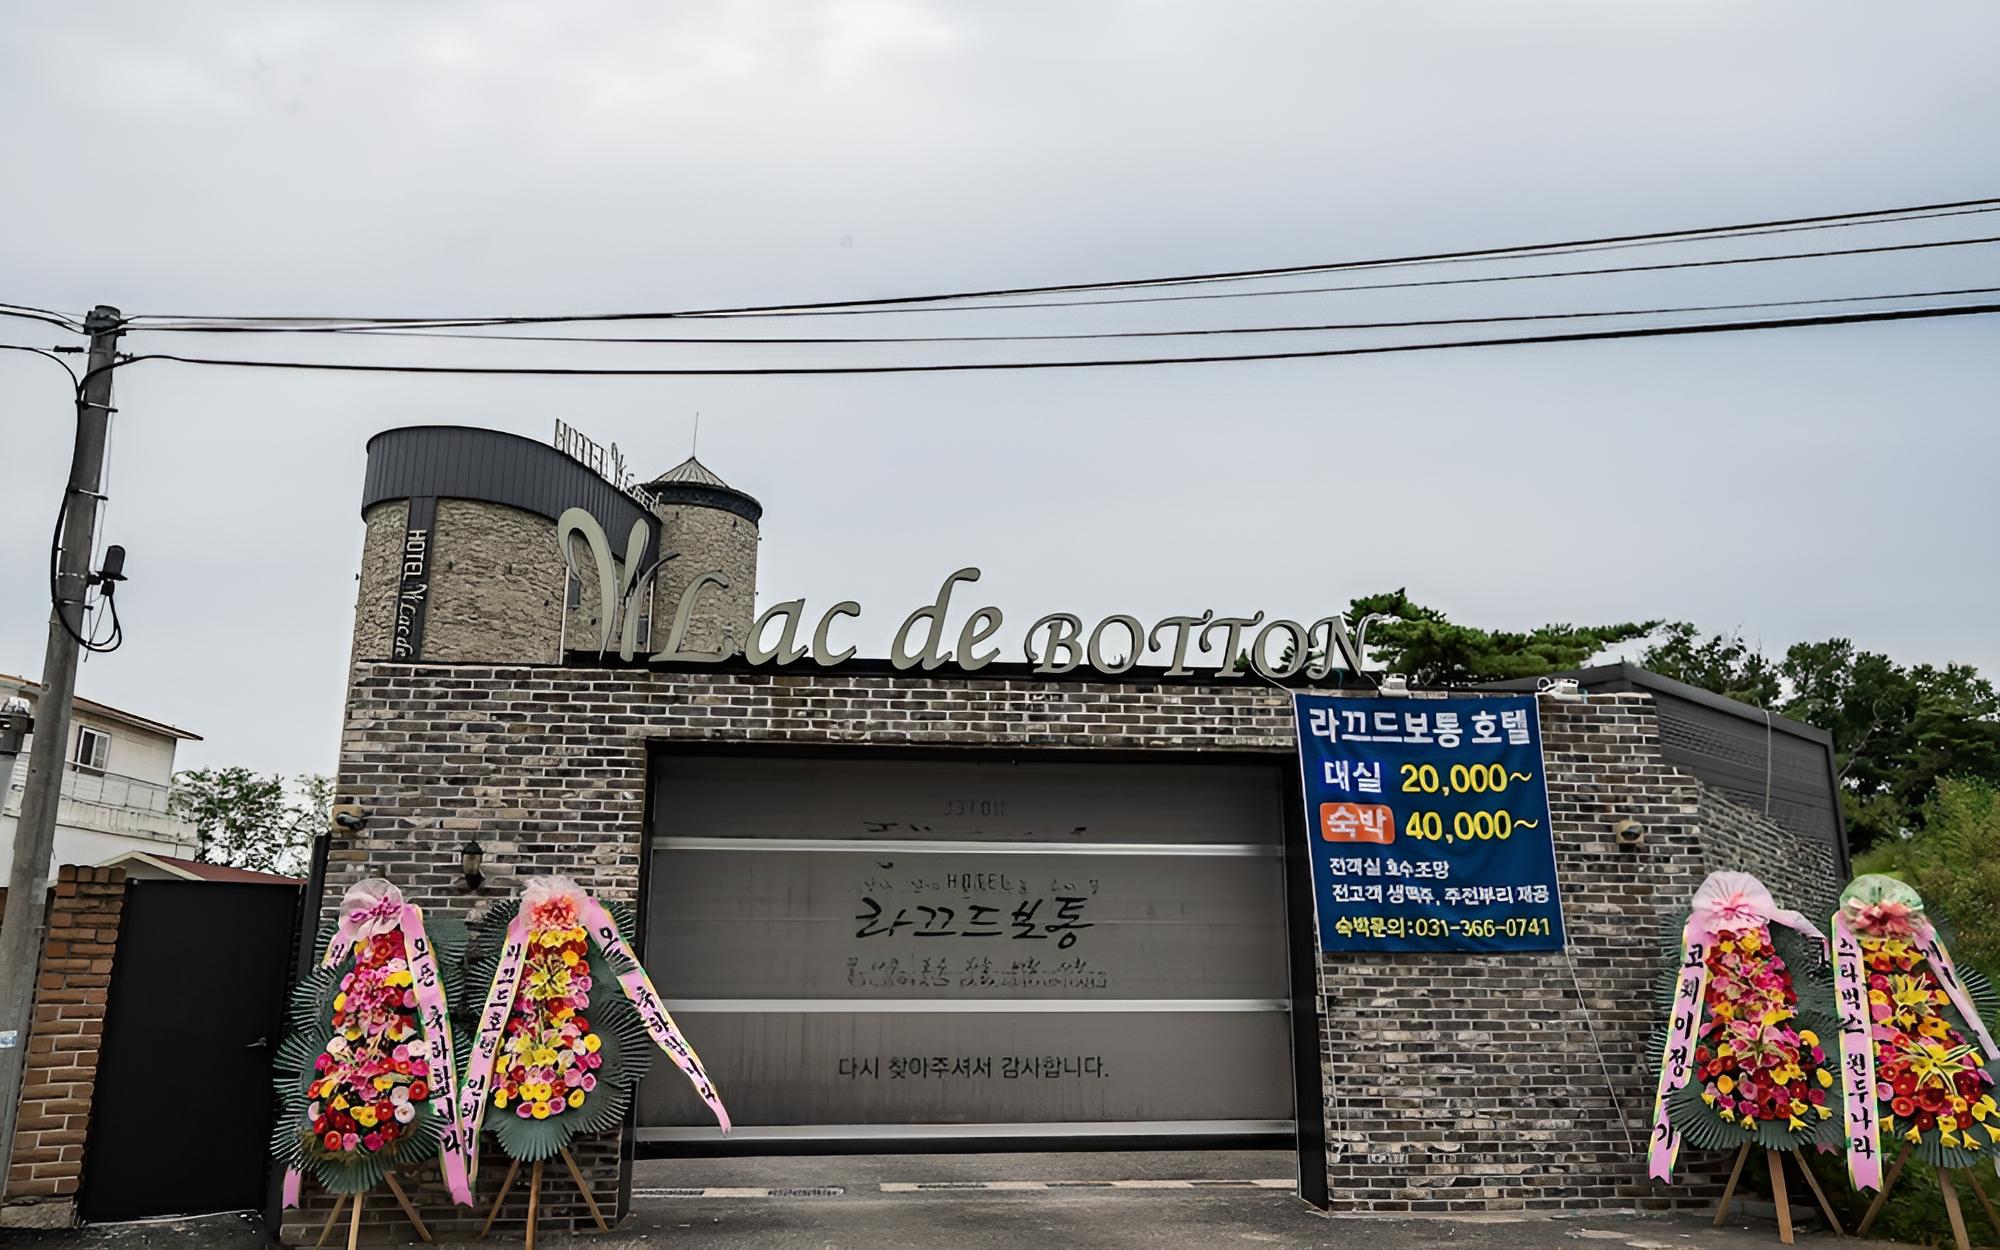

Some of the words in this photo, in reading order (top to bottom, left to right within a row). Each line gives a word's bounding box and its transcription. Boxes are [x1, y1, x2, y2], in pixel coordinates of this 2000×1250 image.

[402, 529, 428, 581] HOTEL
[649, 572, 861, 668] Lac
[892, 566, 1004, 672] de
[1026, 612, 1386, 680] BOTTON
[1309, 707, 1464, 749] 라끄드보통
[1471, 709, 1531, 746] 호텔
[1323, 760, 1383, 794] 대실
[1400, 763, 1533, 797] 20,000~
[1326, 806, 1388, 841] 숙박
[1405, 810, 1539, 844] 40,000~
[1329, 857, 1382, 877] 전객실
[1384, 858, 1450, 880] 호수조망
[838, 1056, 880, 1080] 다시
[888, 1056, 992, 1080] 찾아주셔서
[1001, 1055, 1110, 1080] 감사합니다.
